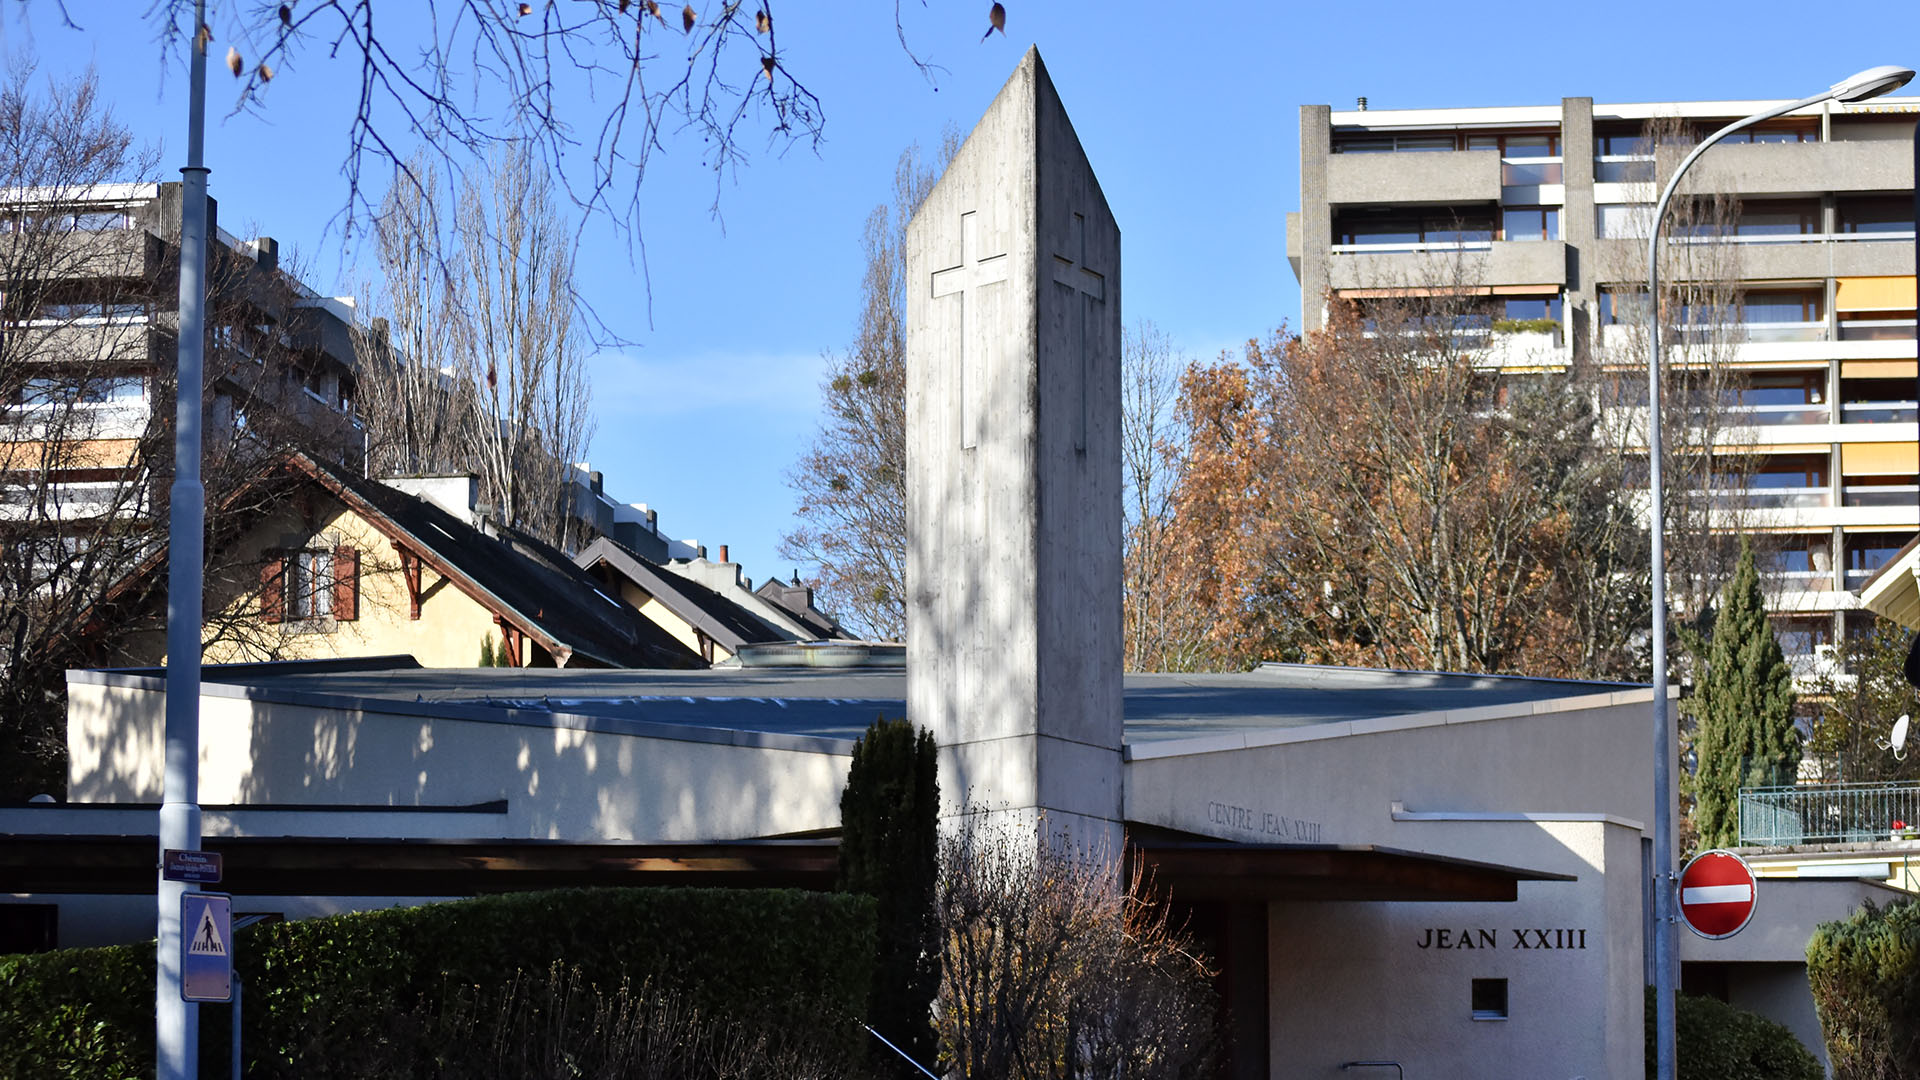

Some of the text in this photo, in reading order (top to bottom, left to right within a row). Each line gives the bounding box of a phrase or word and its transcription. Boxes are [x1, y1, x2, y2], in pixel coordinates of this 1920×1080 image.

[1208, 801, 1321, 843] CENTRE JEAN XXIII
[1416, 928, 1587, 949] JEAN XXIII
